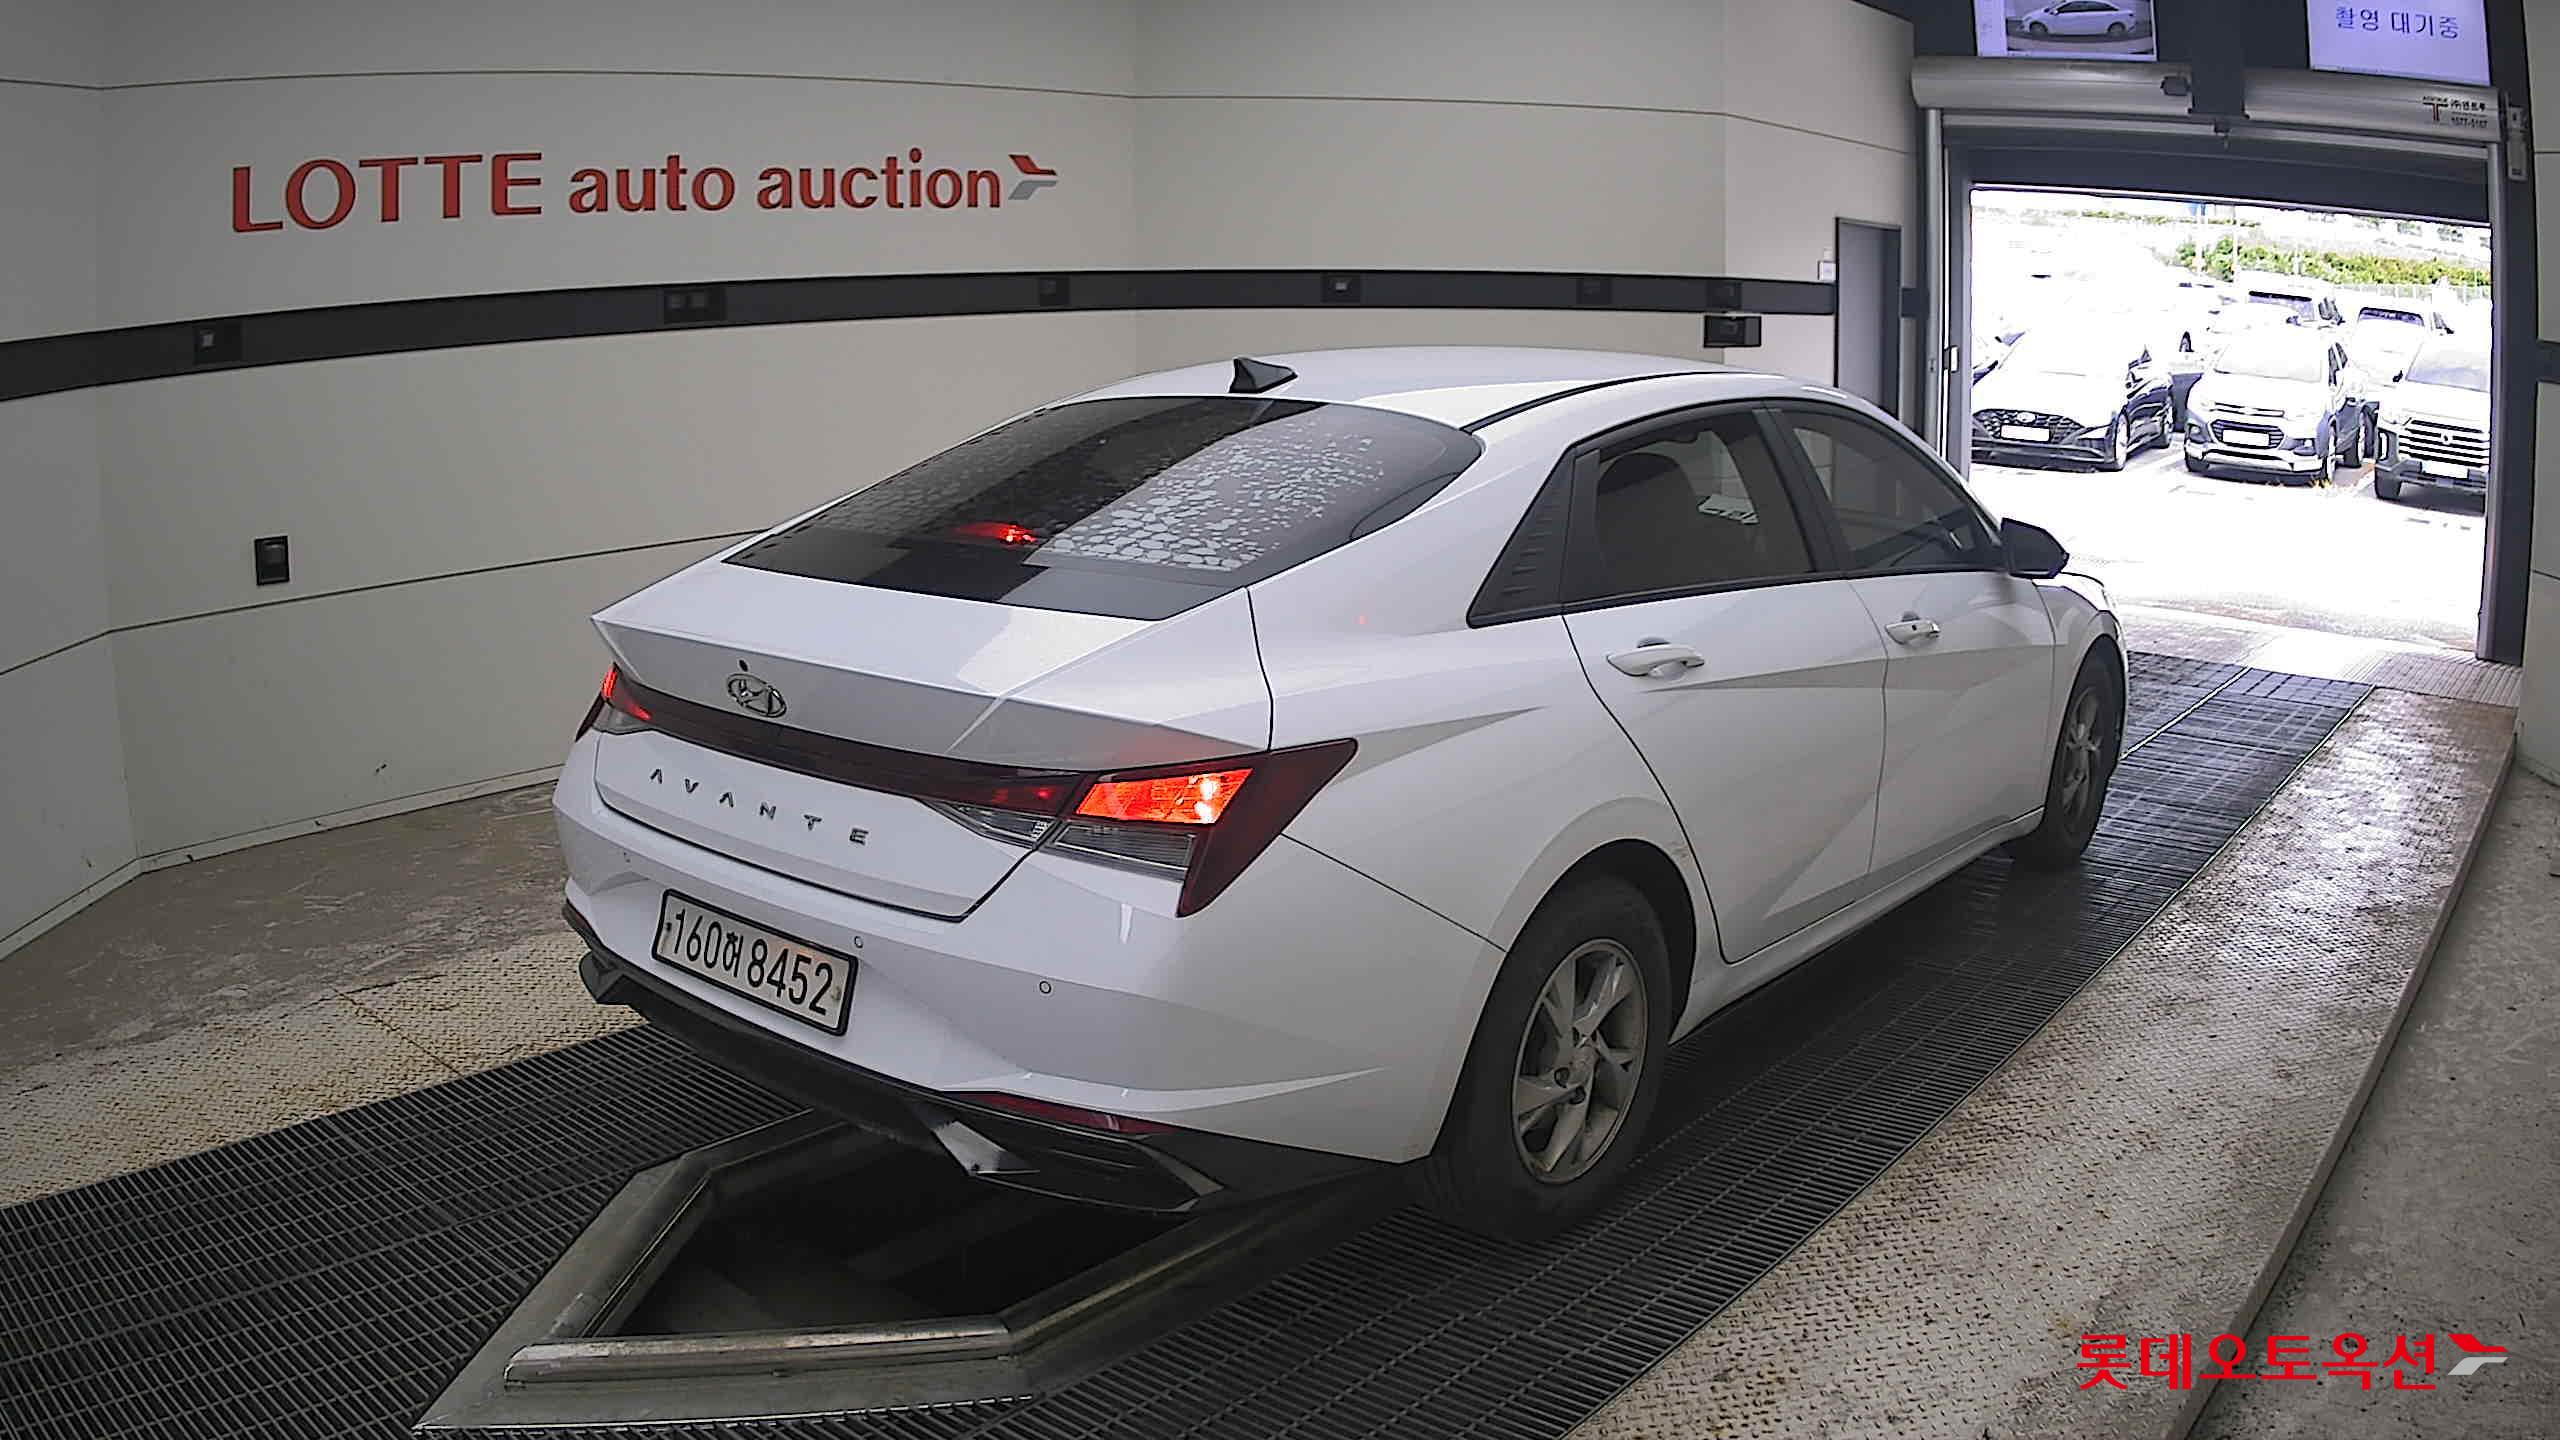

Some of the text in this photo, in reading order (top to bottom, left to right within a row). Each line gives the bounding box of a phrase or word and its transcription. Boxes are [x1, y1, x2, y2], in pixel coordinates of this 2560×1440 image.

[2336, 6, 2459, 39] 촬영 대기중
[232, 148, 1002, 232] LOTTE auto auction
[649, 767, 870, 846] AVANTE
[673, 908, 833, 1016] 160허 8452
